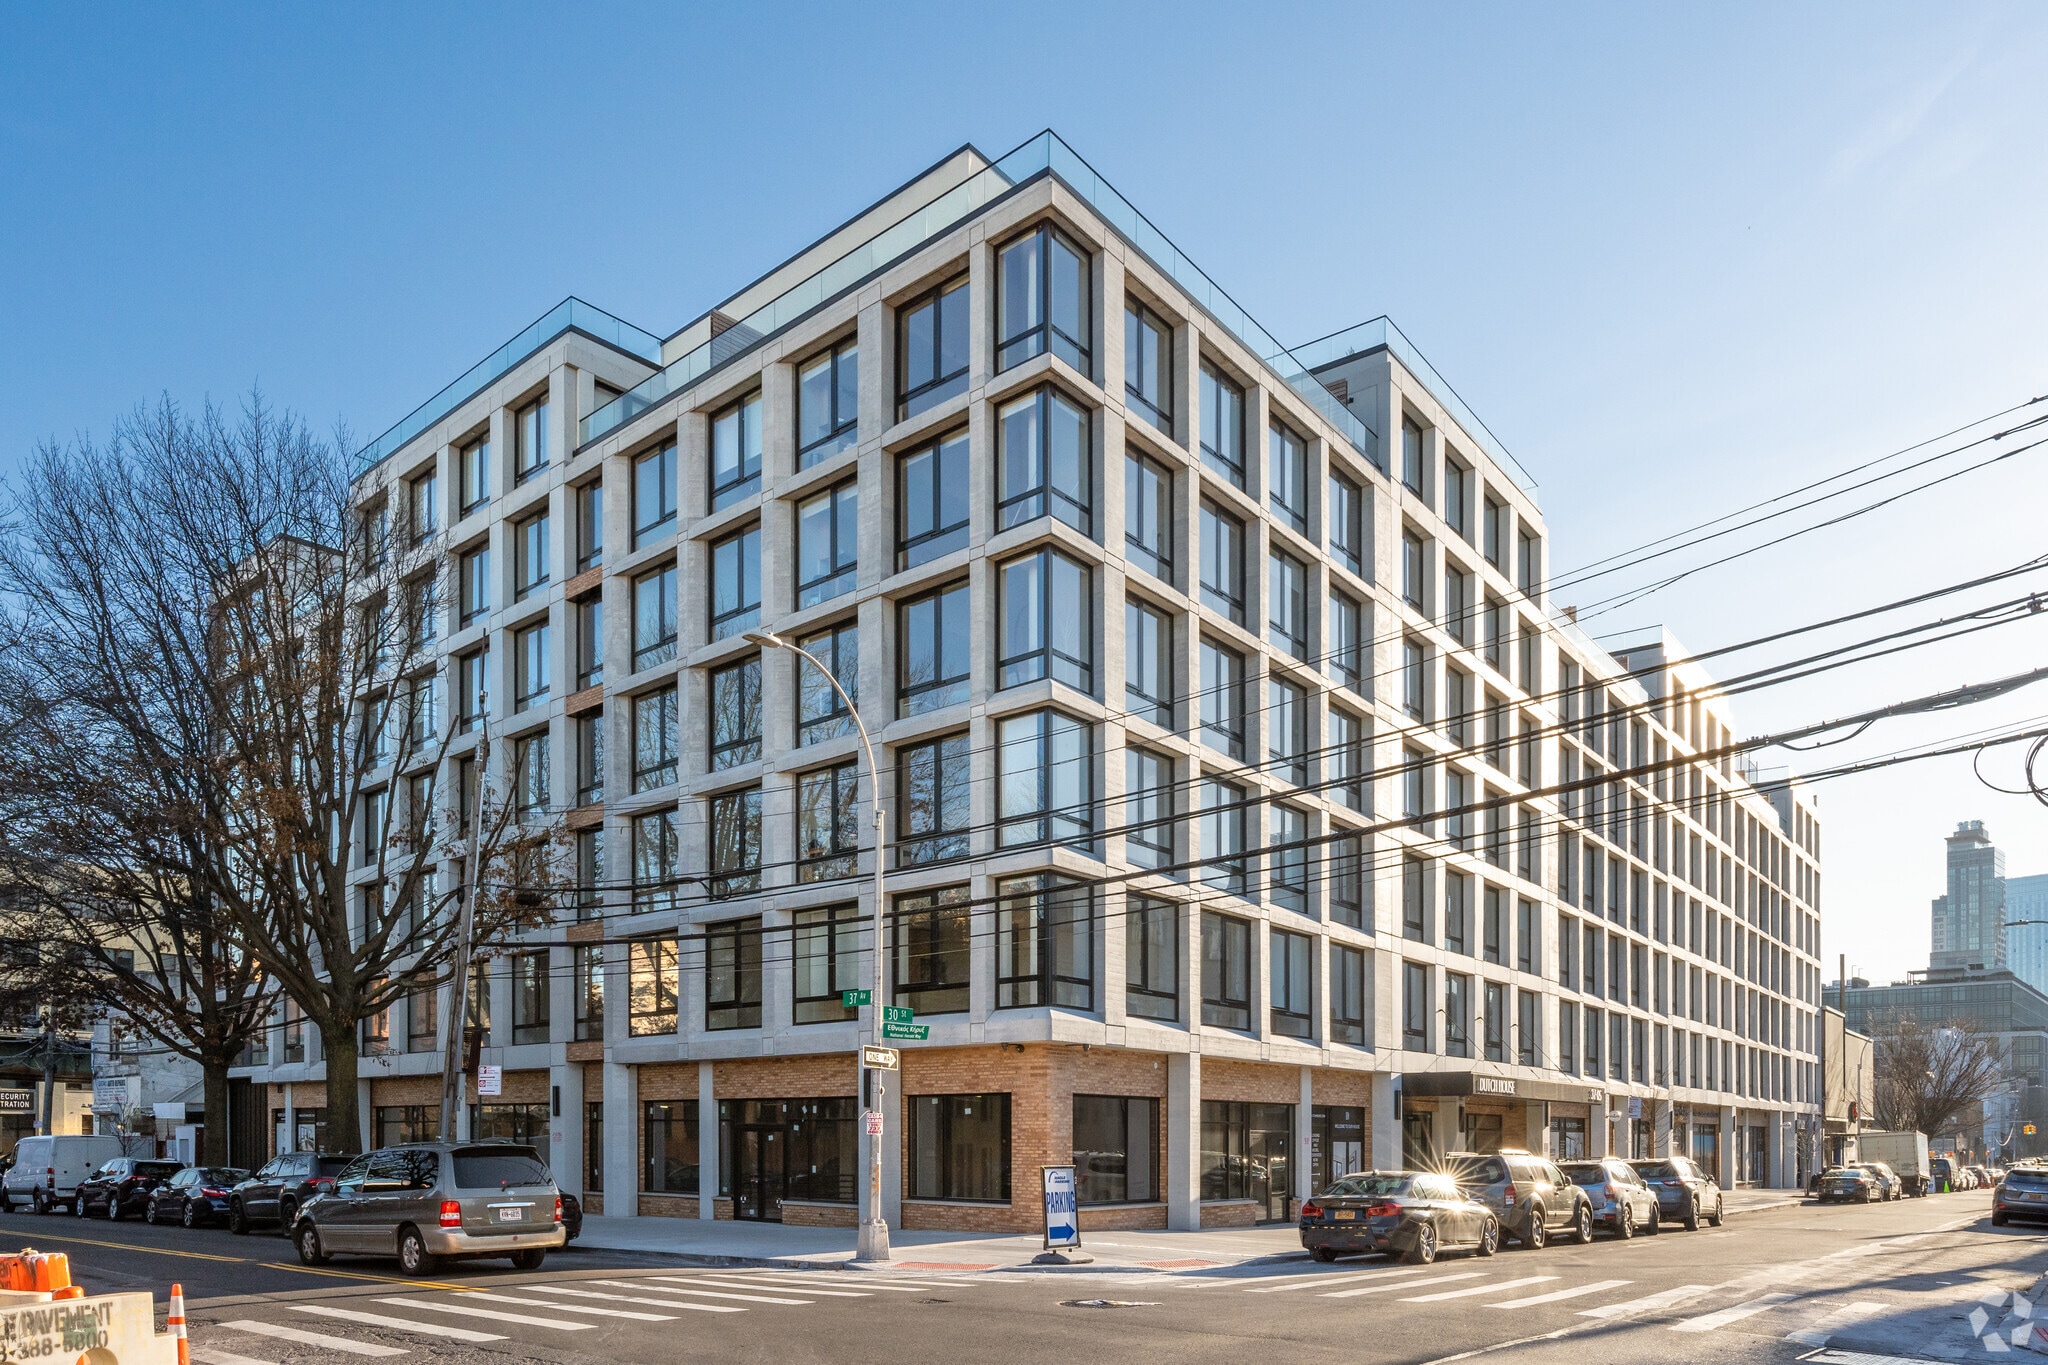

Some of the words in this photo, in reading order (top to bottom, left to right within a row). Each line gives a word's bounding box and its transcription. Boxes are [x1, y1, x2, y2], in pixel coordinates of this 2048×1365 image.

[849, 992, 858, 1005] 37
[860, 992, 866, 1000] Av
[888, 1008, 898, 1021] 30
[901, 1010, 907, 1018] St
[869, 1052, 880, 1062] ONE
[883, 1054, 894, 1062] WAY
[1479, 1078, 1498, 1092] DUTCH
[1499, 1080, 1516, 1094] HOUSE
[1046, 1191, 1075, 1214] PARKING
[20, 1302, 113, 1337] PAVEMENT
